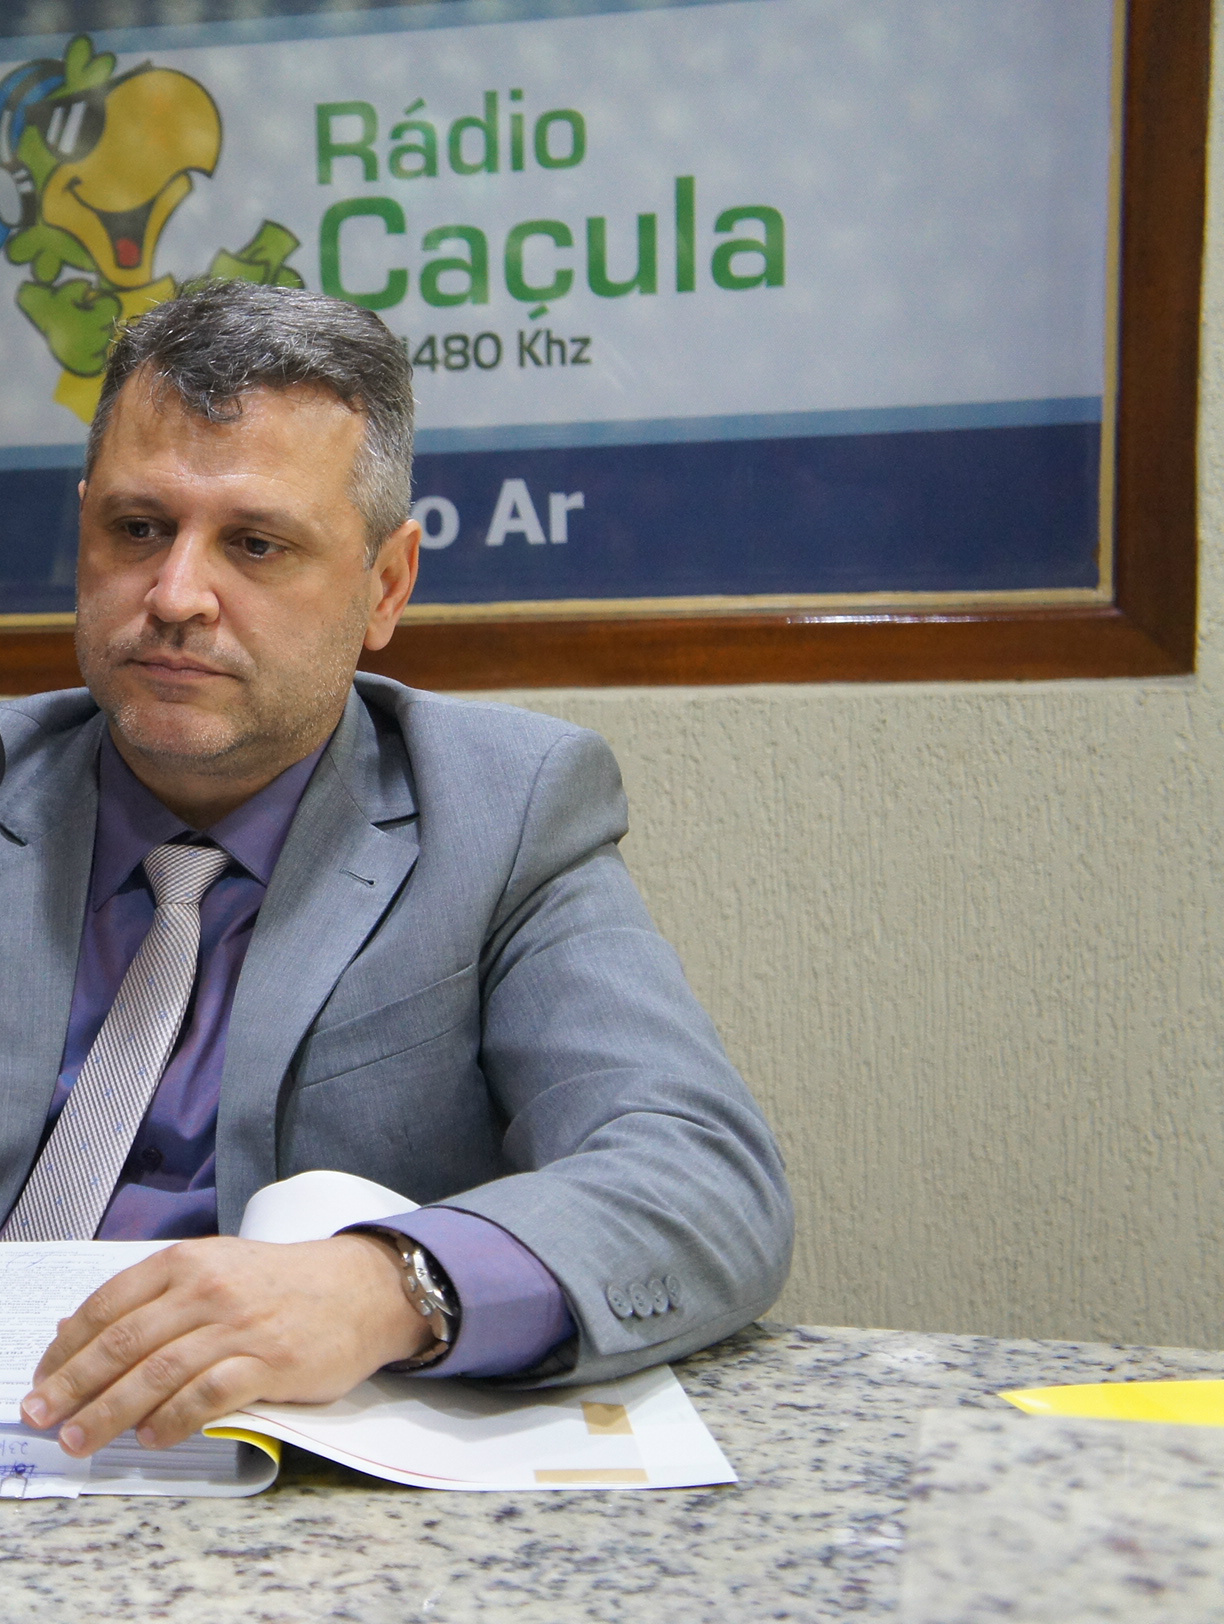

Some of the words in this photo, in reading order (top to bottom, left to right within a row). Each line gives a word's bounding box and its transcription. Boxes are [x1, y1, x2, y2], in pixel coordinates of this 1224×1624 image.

[315, 88, 587, 185] Rádio
[319, 175, 786, 319] Caçula
[518, 328, 592, 369] Khz
[485, 477, 585, 547] Ar
